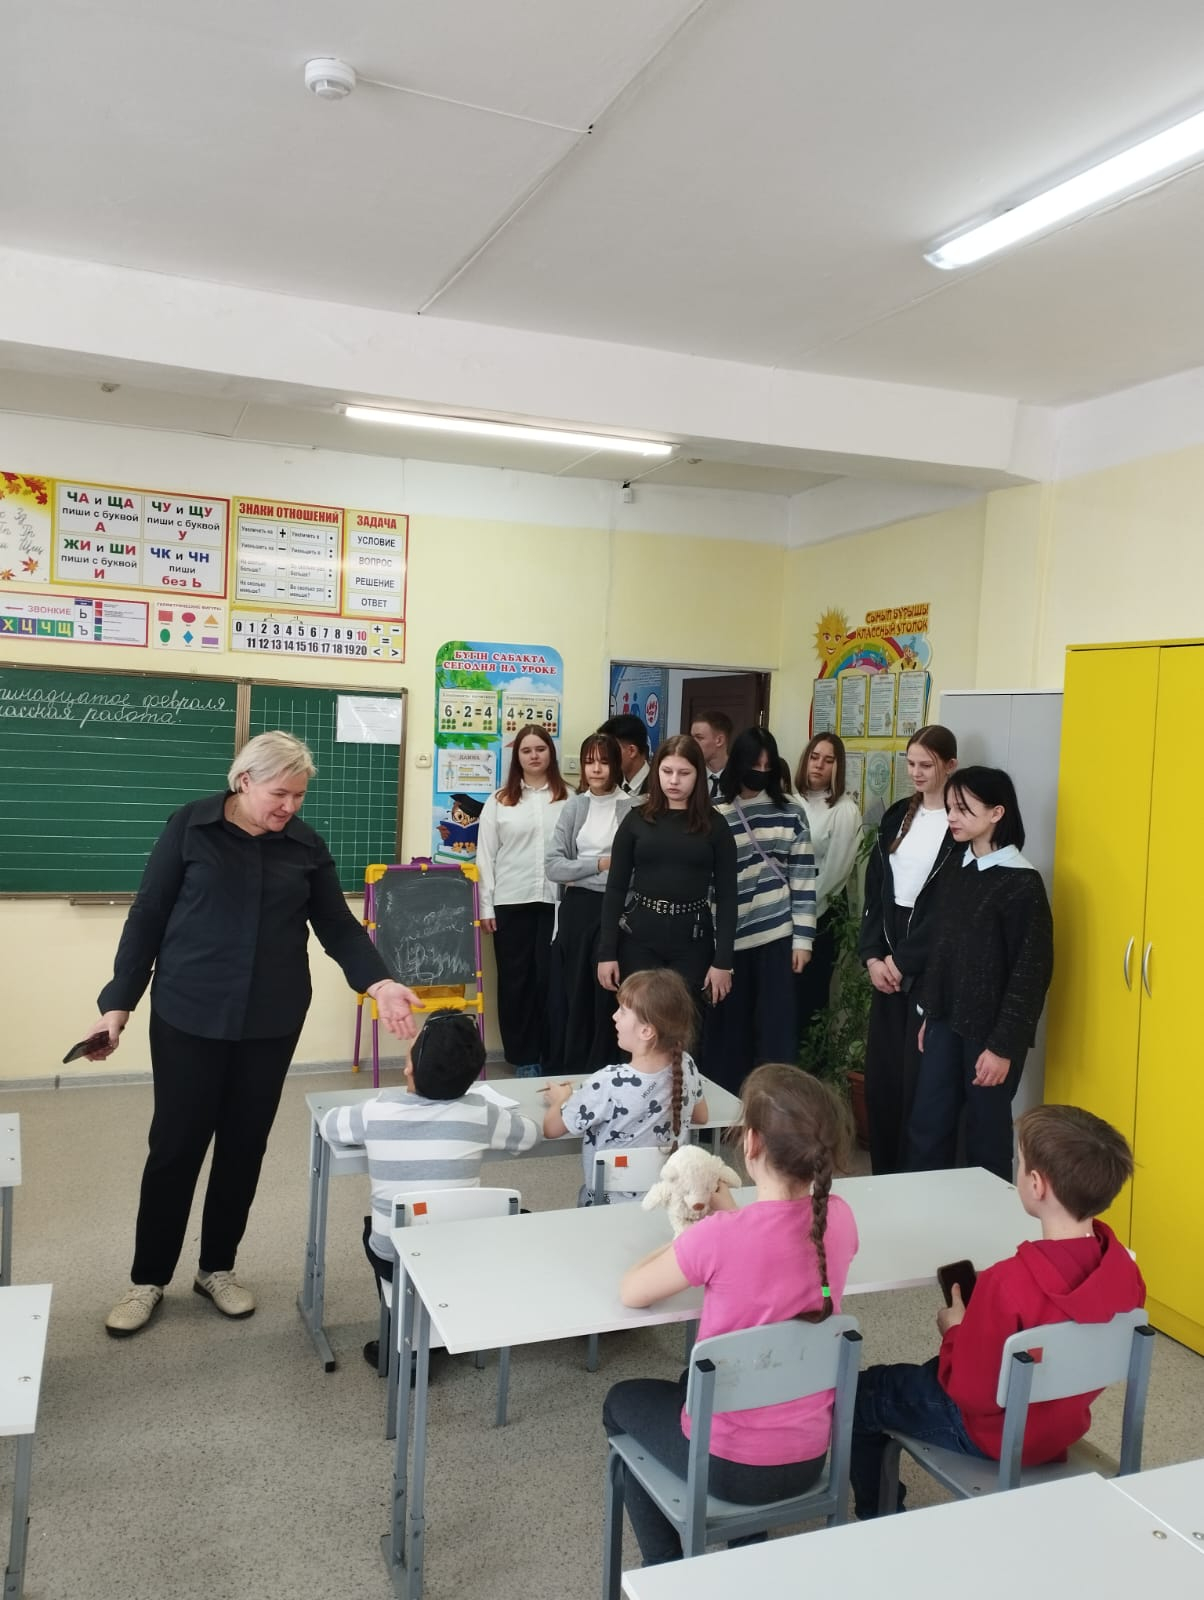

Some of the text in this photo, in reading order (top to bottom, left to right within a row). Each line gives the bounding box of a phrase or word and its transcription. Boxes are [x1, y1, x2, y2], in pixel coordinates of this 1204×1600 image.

[67, 491, 134, 509] ЧА и ЩА
[62, 507, 90, 517] пиши
[102, 510, 139, 522] буквой
[152, 501, 213, 518] ЧУ и ЩУ
[239, 502, 339, 524] ЗНАКИ ОТНОШЕНИЙ
[95, 522, 106, 532] А
[147, 516, 174, 526] пиши
[185, 519, 220, 531] буквой
[357, 514, 397, 530] ЗАДАЧА
[178, 530, 187, 541] У
[357, 536, 396, 548] УСЛОВИЕ
[64, 538, 91, 551] ЖИ
[110, 543, 136, 556] ШИ
[61, 554, 89, 564] пиши
[101, 557, 137, 569] буквой
[150, 547, 209, 563] ЧК и ЧН
[359, 556, 392, 567] ВОПРОС
[94, 568, 105, 579] И
[169, 565, 196, 574] пиши
[162, 576, 187, 587] без
[355, 577, 395, 588] РЕШЕНИЕ
[27, 605, 72, 615] ЗВОНКИЕ
[361, 598, 387, 608] ОТВЕТ
[2, 619, 71, 637] Х Ц Ч Щ
[236, 621, 367, 641] 0 1 2 3 4 5 6 7 8 9 10
[247, 638, 367, 656] 11 12 13 14 15 16 17 18 19 20
[443, 661, 557, 675] СЕГОДНЯ НА УРОКЕ
[444, 705, 452, 717] 6
[464, 706, 472, 718] 2
[484, 707, 492, 718] 4
[507, 707, 514, 719] 4
[526, 708, 533, 720] 2
[545, 709, 553, 721] 6
